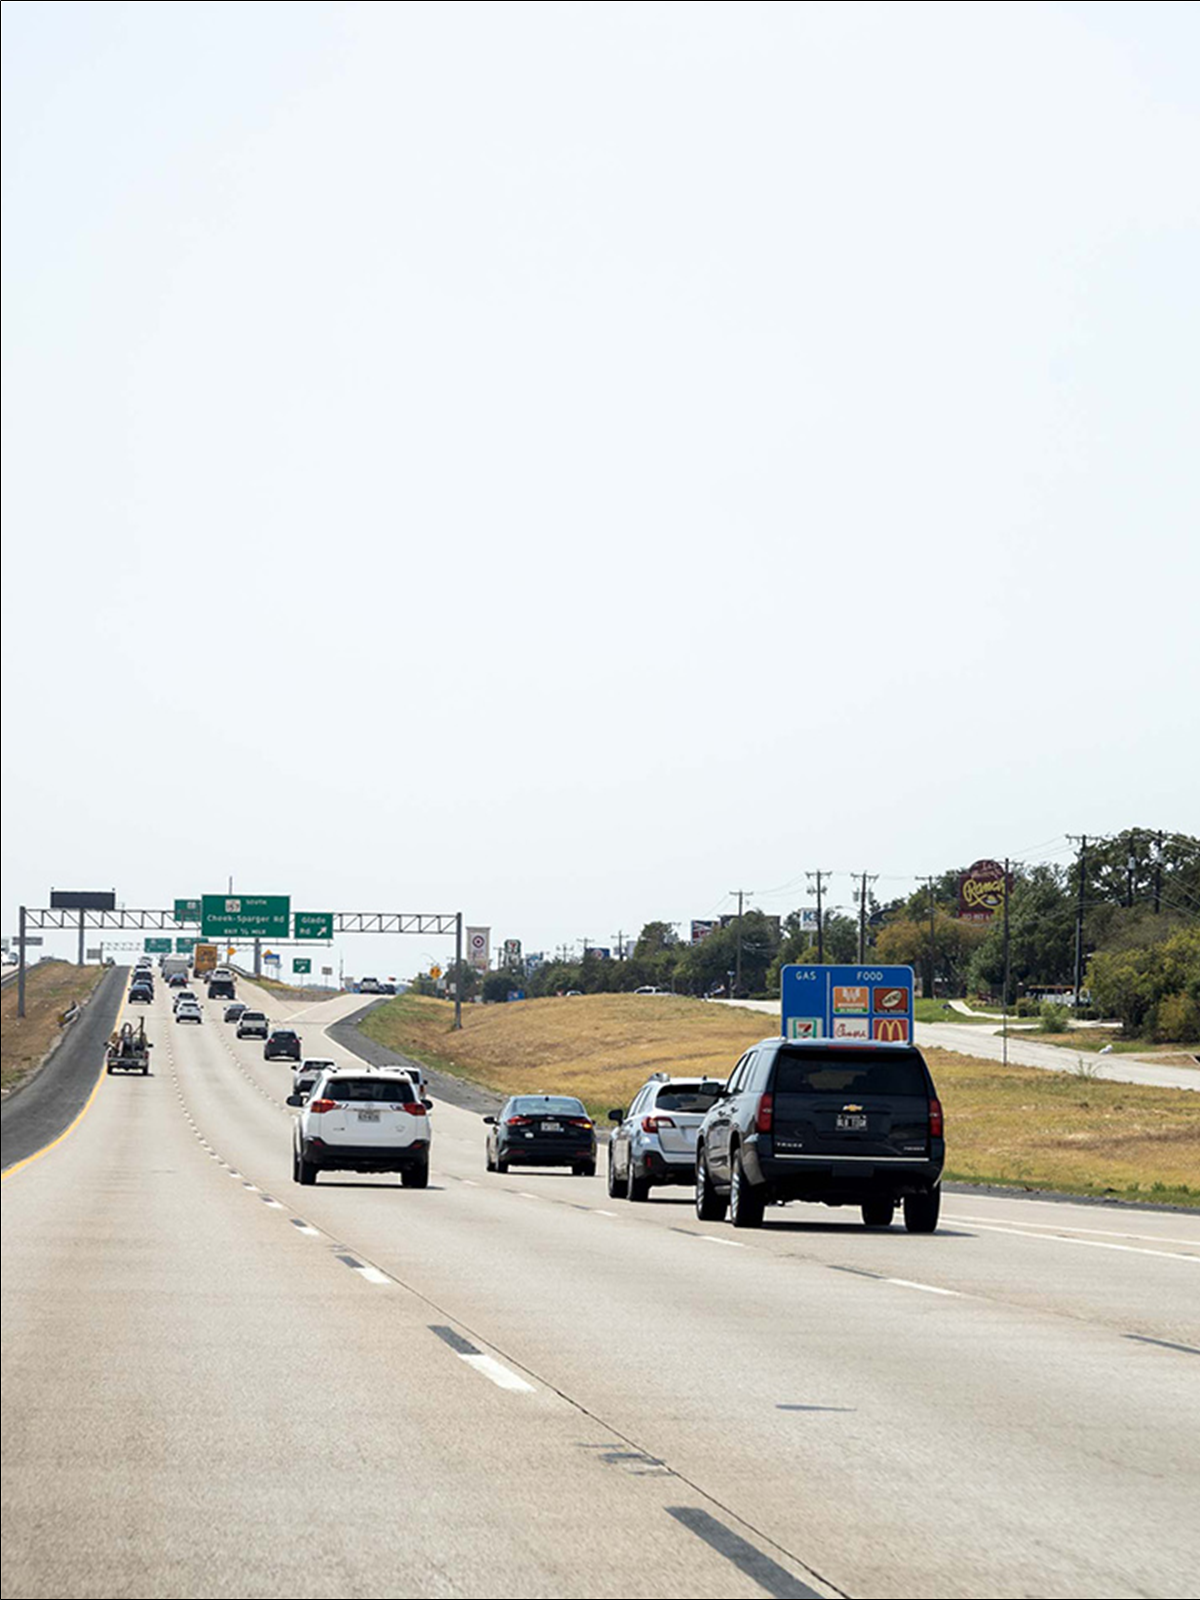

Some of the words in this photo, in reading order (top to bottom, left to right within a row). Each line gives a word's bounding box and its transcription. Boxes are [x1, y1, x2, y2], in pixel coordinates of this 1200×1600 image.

[206, 914, 270, 924] Cheek-Sparger
[301, 916, 326, 924] Glade
[299, 927, 311, 935] Rd
[796, 971, 817, 980] GAS
[857, 971, 883, 981] FOOD
